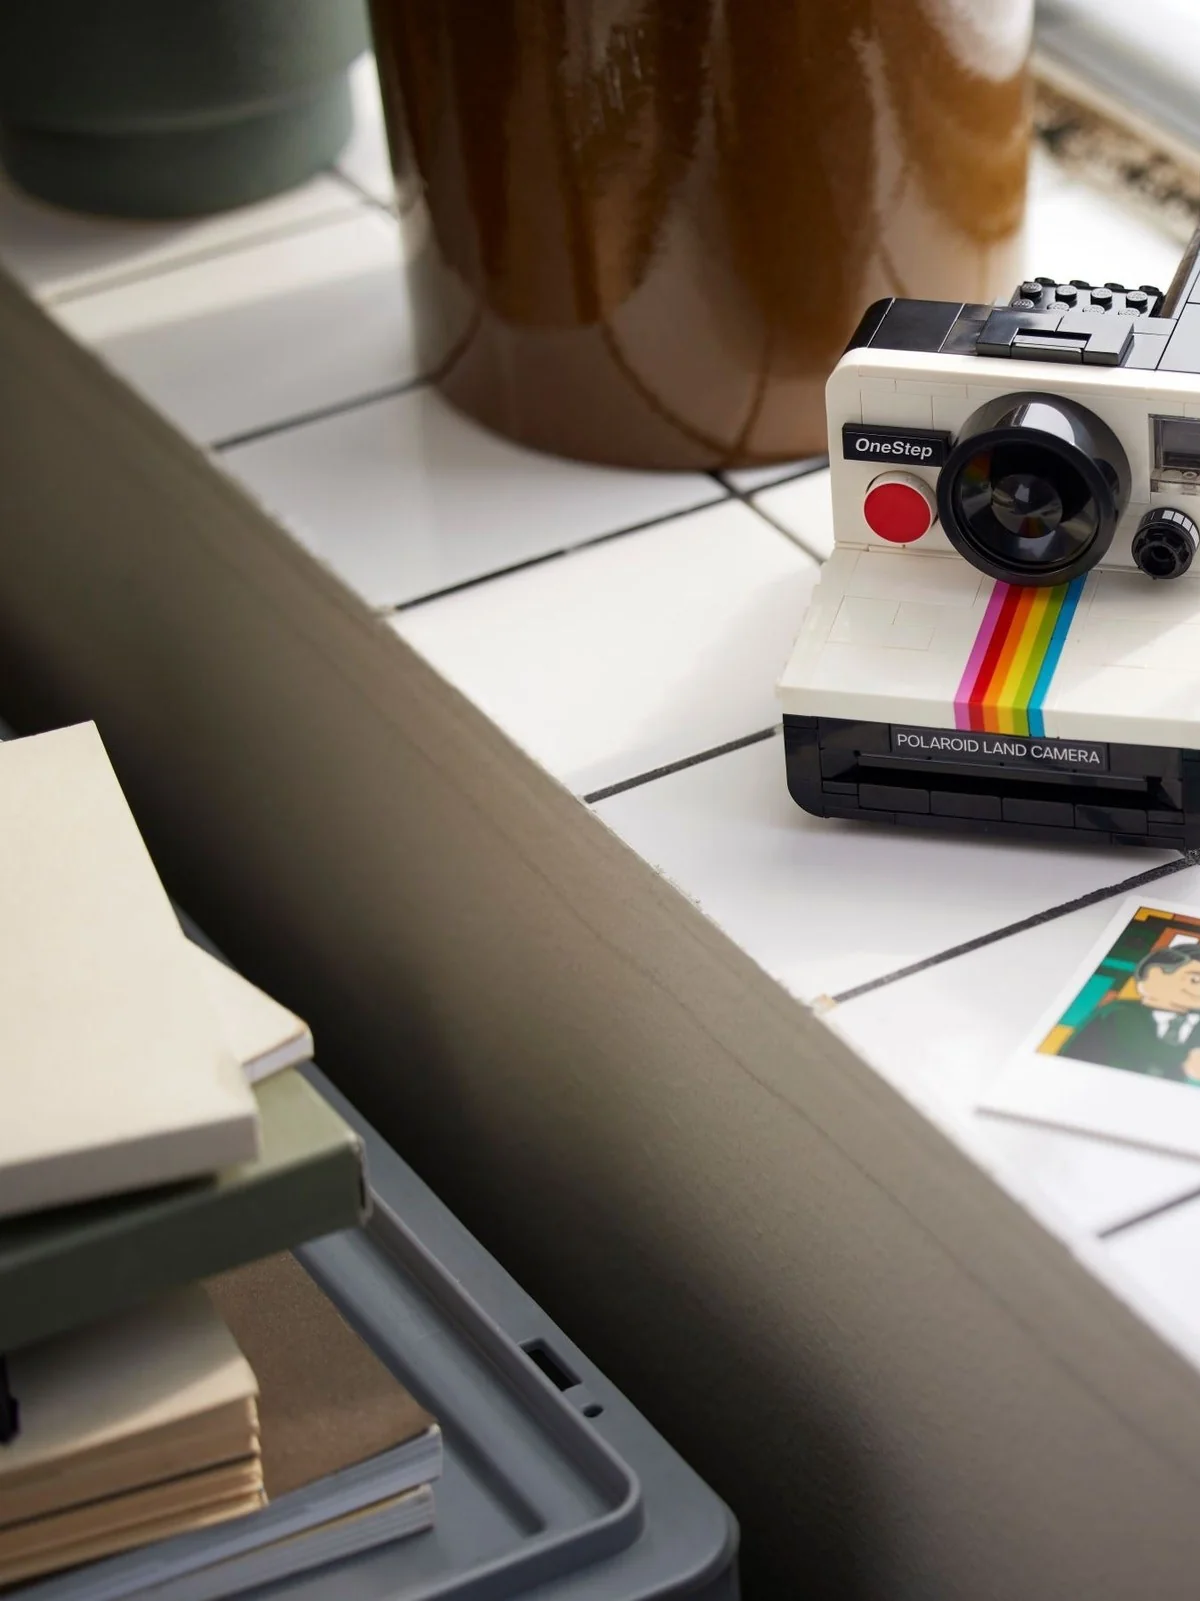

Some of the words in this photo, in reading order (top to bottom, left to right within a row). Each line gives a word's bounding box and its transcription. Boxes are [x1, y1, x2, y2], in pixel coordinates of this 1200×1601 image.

[855, 438, 933, 460] OneStep
[897, 734, 979, 753] POLAROID
[983, 741, 1027, 757] LAND
[1031, 745, 1100, 764] CAMERA
